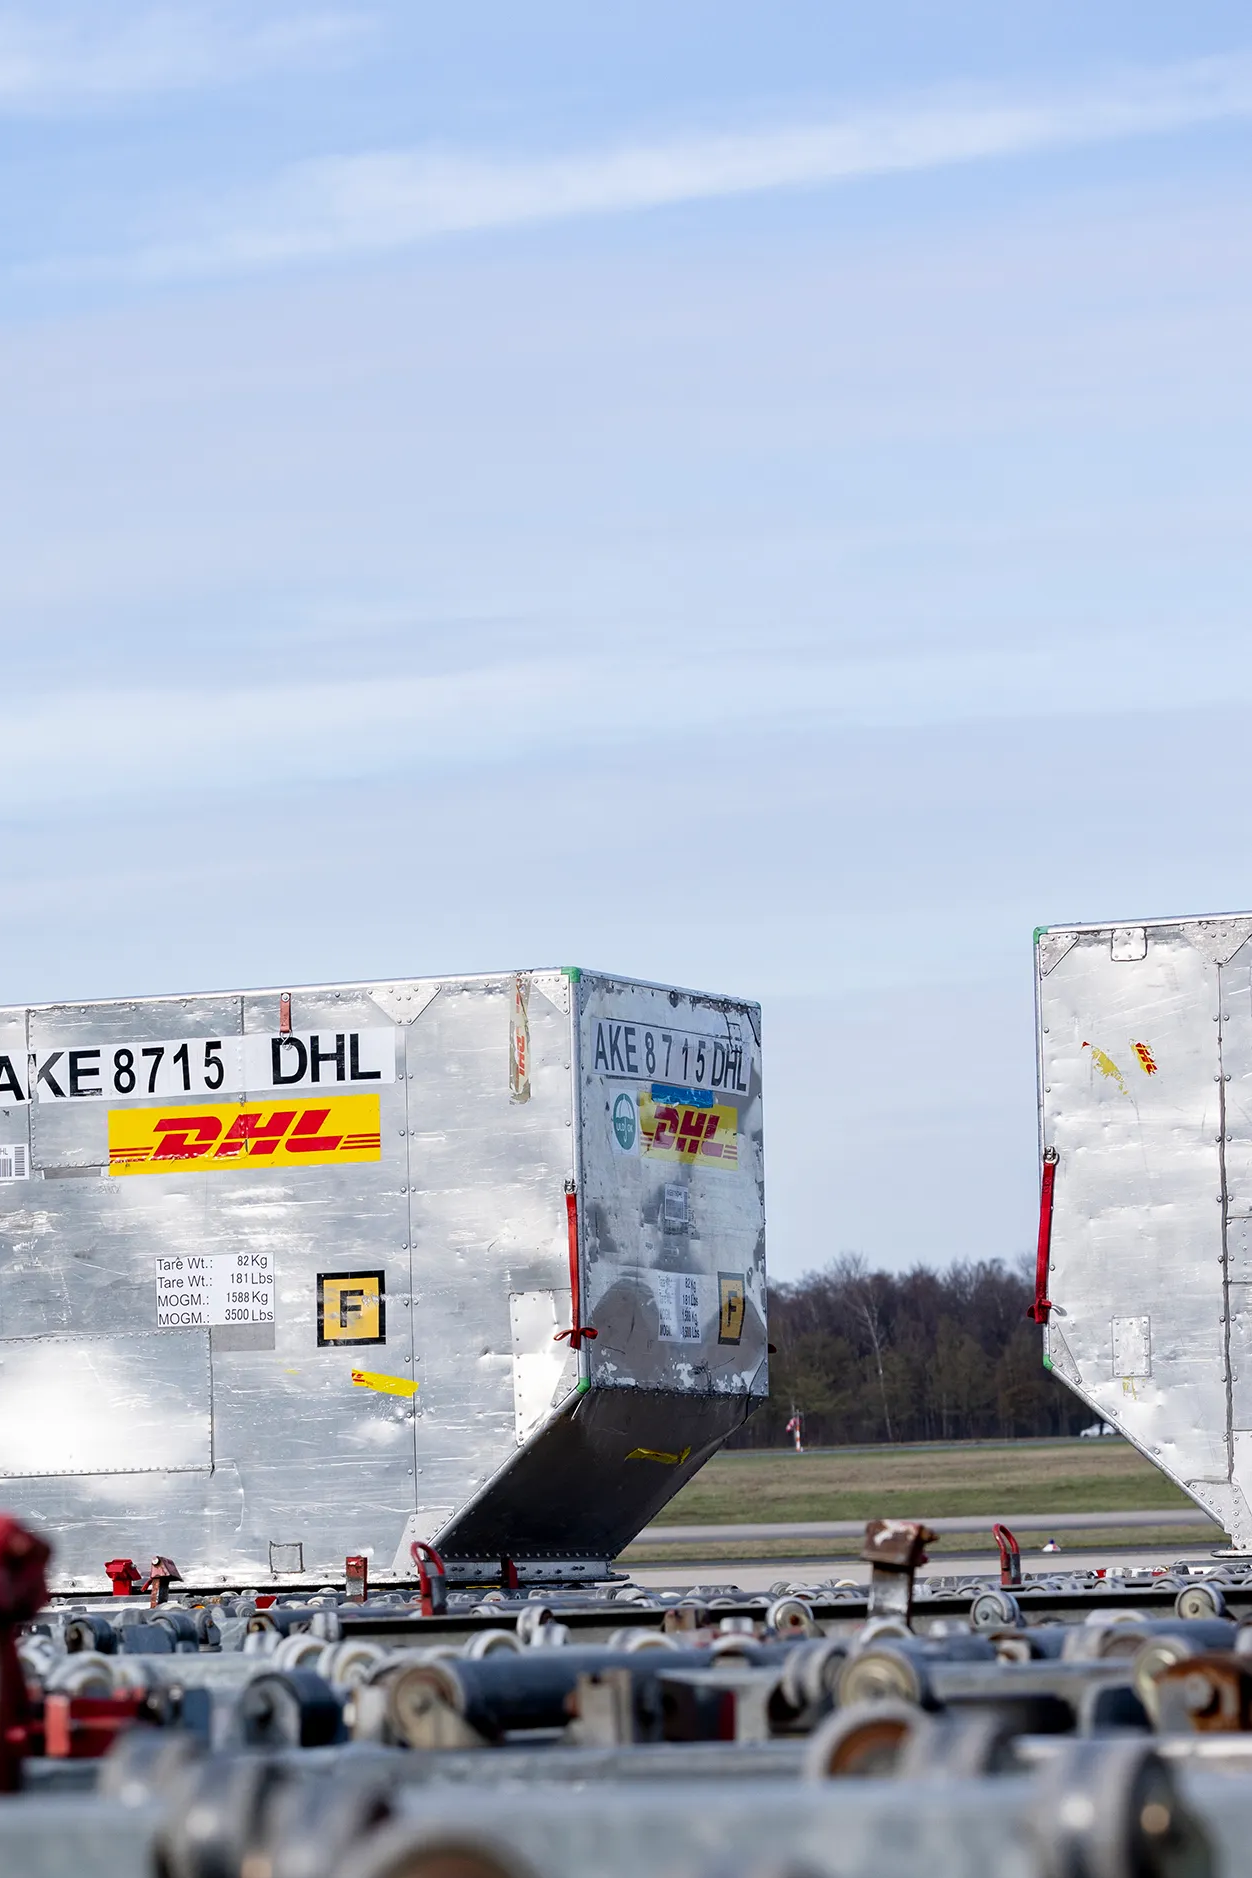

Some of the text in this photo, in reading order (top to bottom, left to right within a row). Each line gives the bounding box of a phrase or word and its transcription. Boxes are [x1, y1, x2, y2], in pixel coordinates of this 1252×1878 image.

[113, 1040, 224, 1094] 8715
[271, 1033, 381, 1085] DHL
[594, 1022, 638, 1073] AKE
[711, 1041, 746, 1092] DHL
[148, 1109, 344, 1161] DHL
[652, 1106, 724, 1157] DHL
[157, 1254, 268, 1271] Tare Wt.: 82 Kg
[157, 1272, 273, 1288] Tare Wt.: 181 Lbs
[157, 1290, 268, 1307] MOGM.: 1588 Kg
[159, 1308, 274, 1325] MOGM.: 3500 Lbs
[340, 1289, 364, 1328] F
[728, 1291, 737, 1327] F
